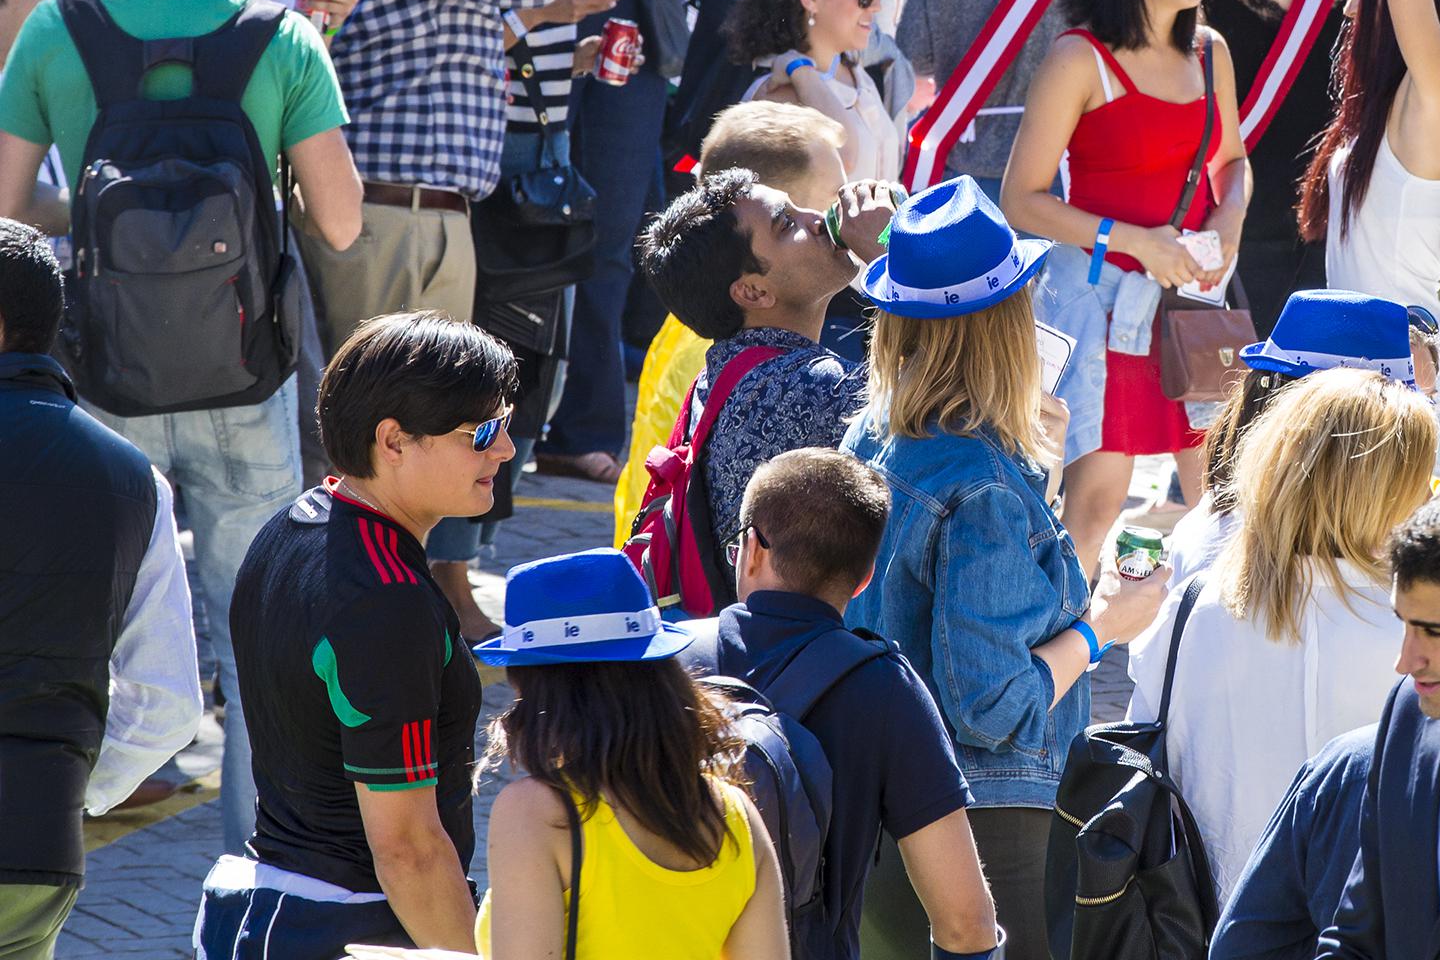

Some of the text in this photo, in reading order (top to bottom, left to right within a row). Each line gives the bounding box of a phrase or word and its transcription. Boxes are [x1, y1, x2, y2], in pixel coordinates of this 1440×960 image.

[944, 291, 960, 304] ie
[986, 276, 1000, 290] ie
[1011, 255, 1020, 268] ie
[1380, 363, 1392, 377] ie
[521, 616, 640, 643] ie ie ie
